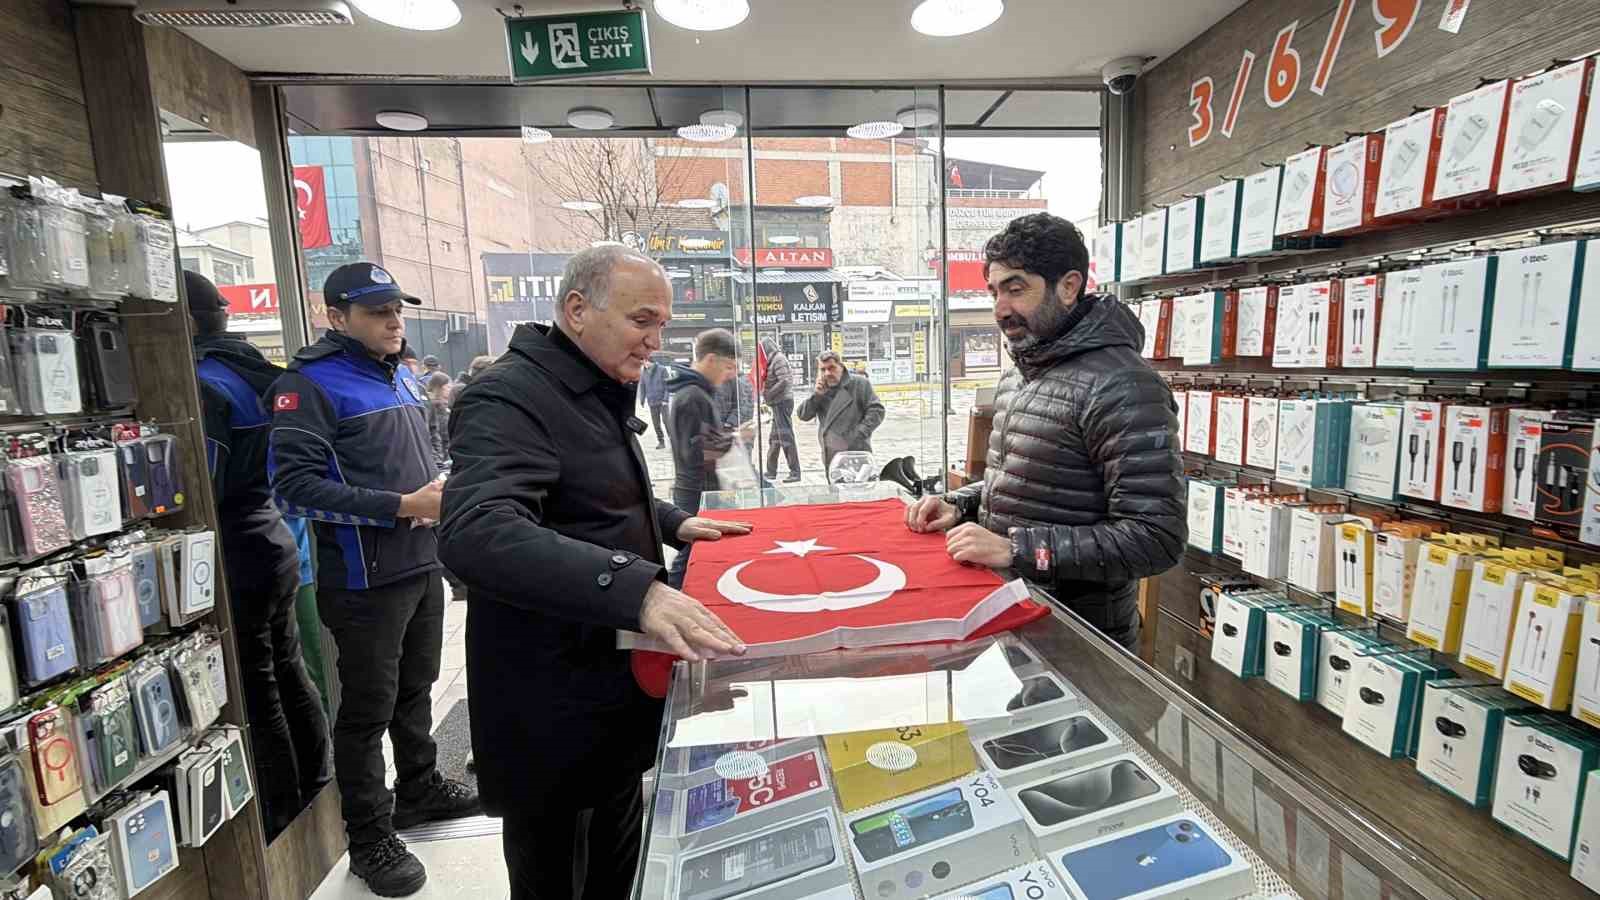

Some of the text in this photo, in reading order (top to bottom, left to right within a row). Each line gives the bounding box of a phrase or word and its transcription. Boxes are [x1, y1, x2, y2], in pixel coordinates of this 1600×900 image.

[587, 25, 630, 43] ÇIKIŞ
[589, 43, 633, 60] EXIT
[765, 251, 826, 262] ALTAN
[793, 303, 826, 311] KALKAN
[969, 777, 996, 808] Y04
[1038, 865, 1056, 889] vivo
